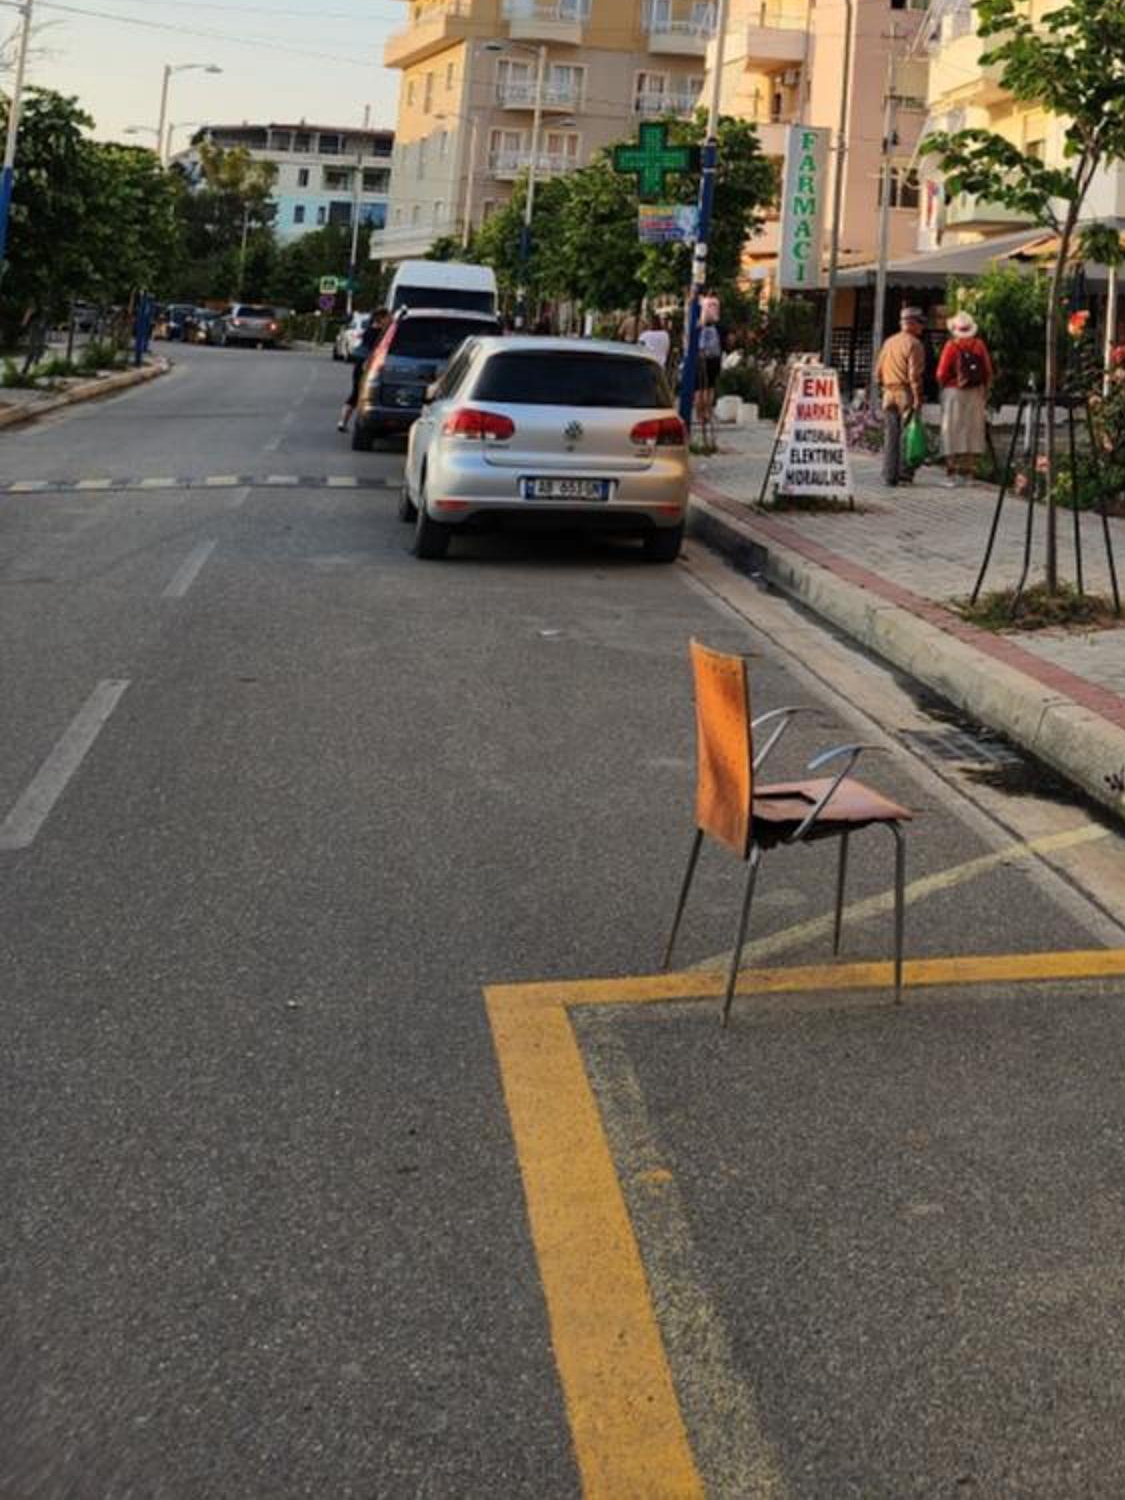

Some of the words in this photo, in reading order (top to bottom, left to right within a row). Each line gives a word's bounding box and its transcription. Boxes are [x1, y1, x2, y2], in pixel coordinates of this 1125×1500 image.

[792, 132, 817, 281] FARMACI
[803, 378, 834, 397] ENI
[796, 403, 839, 420] MARKET
[790, 448, 844, 464] ELEKTRIKE
